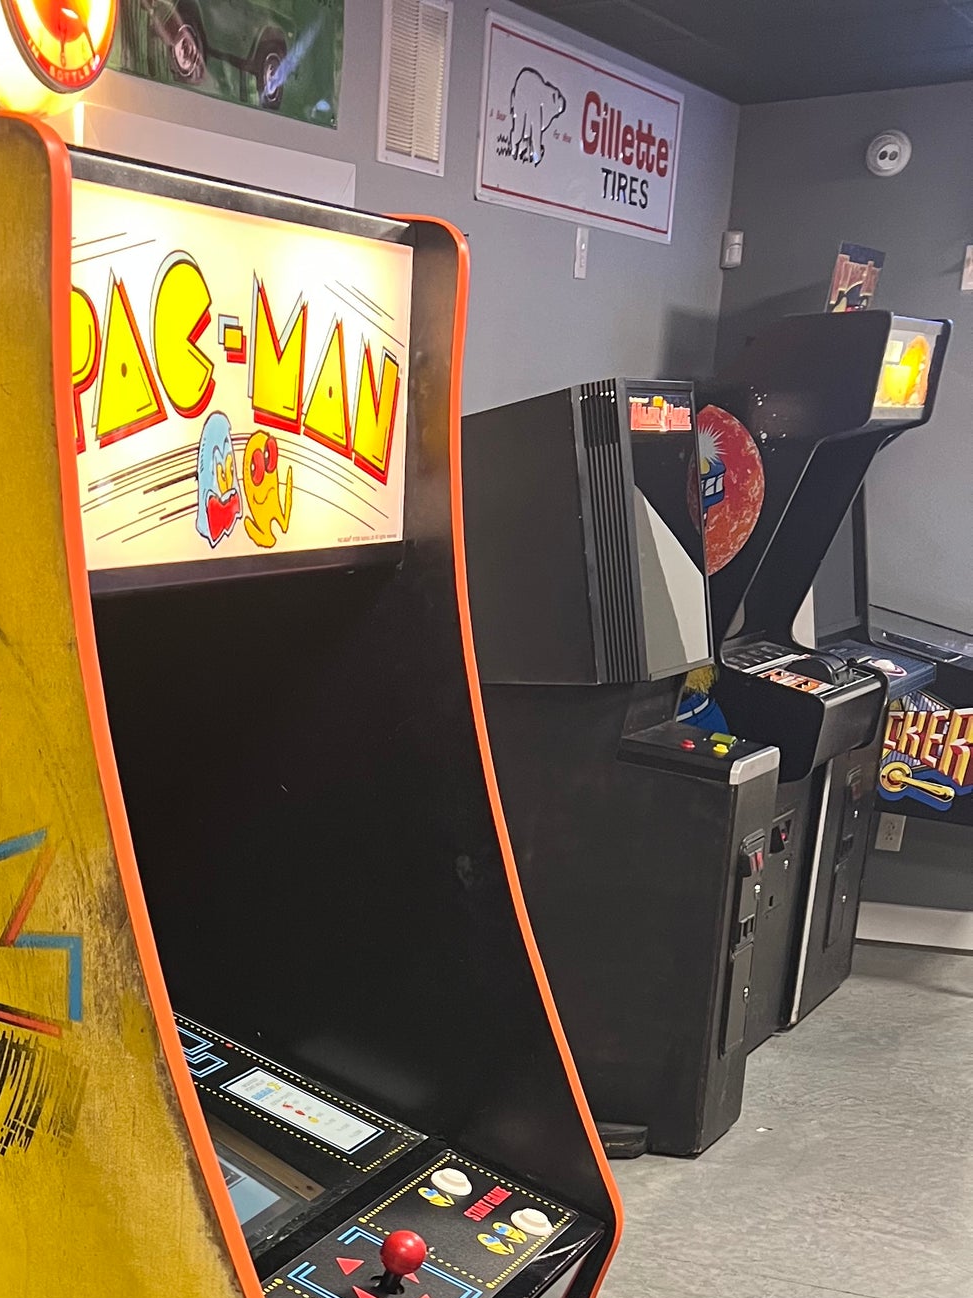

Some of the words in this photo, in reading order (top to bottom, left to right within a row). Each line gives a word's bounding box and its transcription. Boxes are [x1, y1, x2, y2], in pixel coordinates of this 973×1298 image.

[581, 90, 669, 178] Gillette
[601, 167, 649, 209] TIRES
[463, 1199, 495, 1222] START
[483, 1185, 513, 1206] GAME
